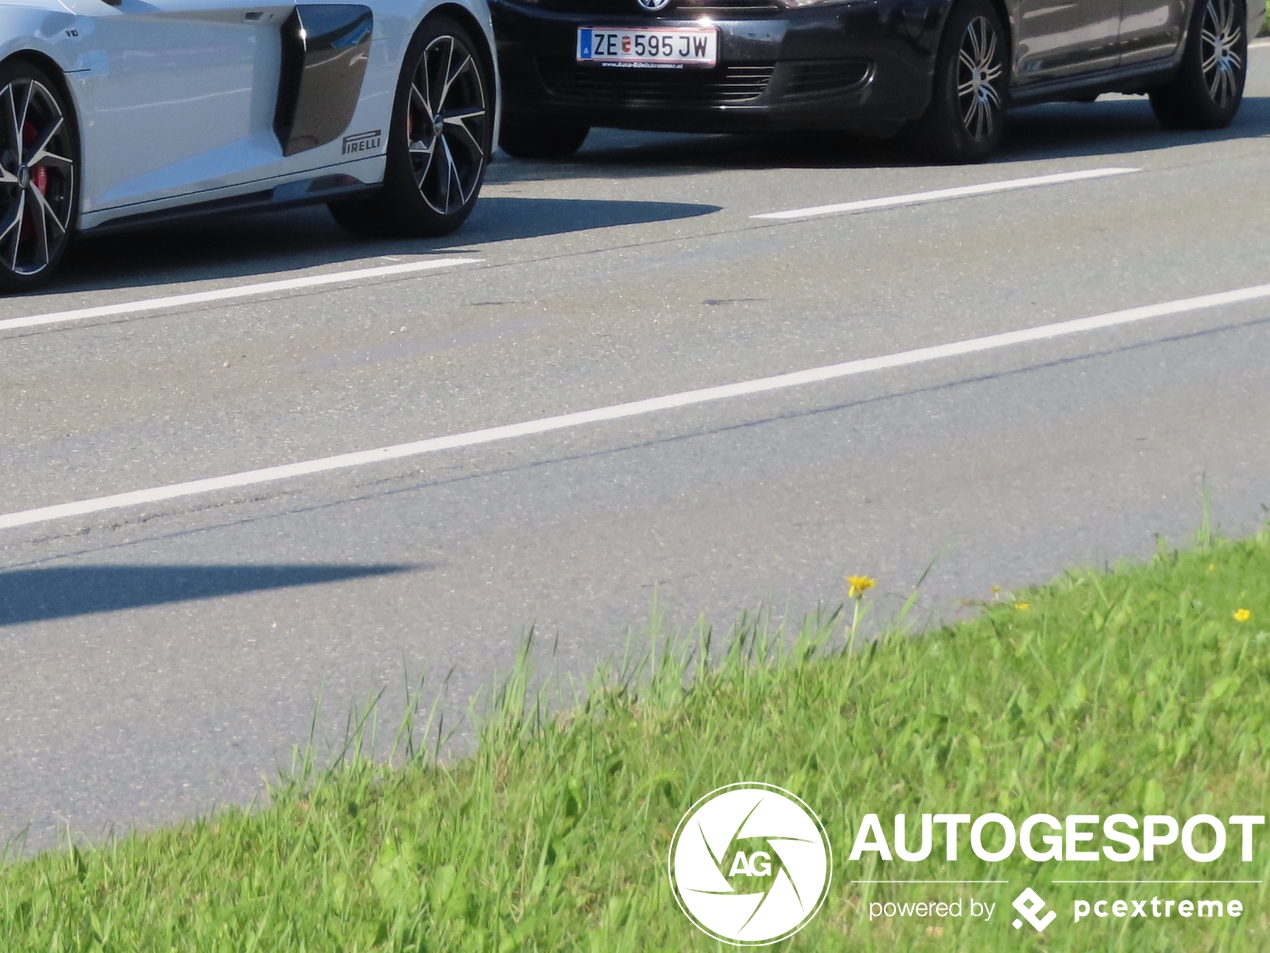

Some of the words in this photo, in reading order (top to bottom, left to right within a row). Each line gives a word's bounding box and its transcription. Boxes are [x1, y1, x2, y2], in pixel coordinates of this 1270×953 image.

[594, 34, 618, 56] ZE
[634, 35, 673, 57] 595
[679, 35, 708, 58] JW
[341, 129, 382, 155] PIRELLI
